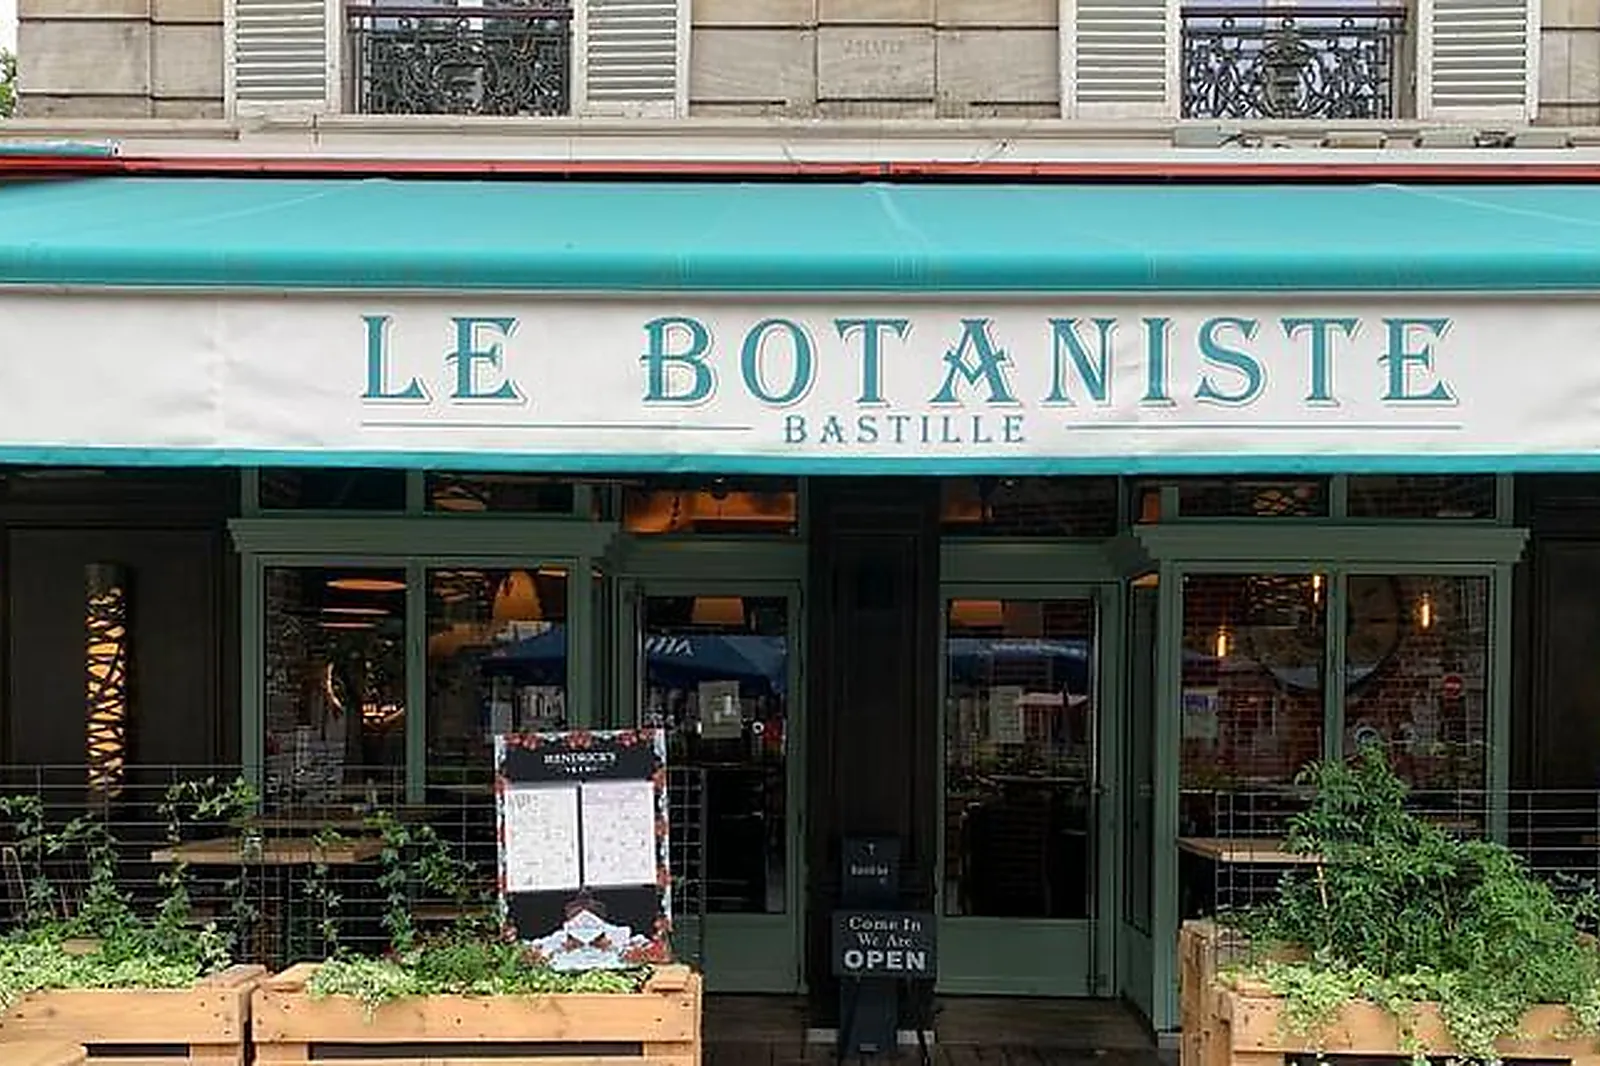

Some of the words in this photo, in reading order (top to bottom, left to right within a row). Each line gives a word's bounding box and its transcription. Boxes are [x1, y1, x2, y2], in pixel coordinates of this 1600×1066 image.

[360, 313, 526, 406] LE
[639, 314, 1459, 408] BOTANISTE
[784, 415, 1025, 445] BASTILLE
[903, 917, 922, 932] In
[844, 949, 926, 970] OPEN
